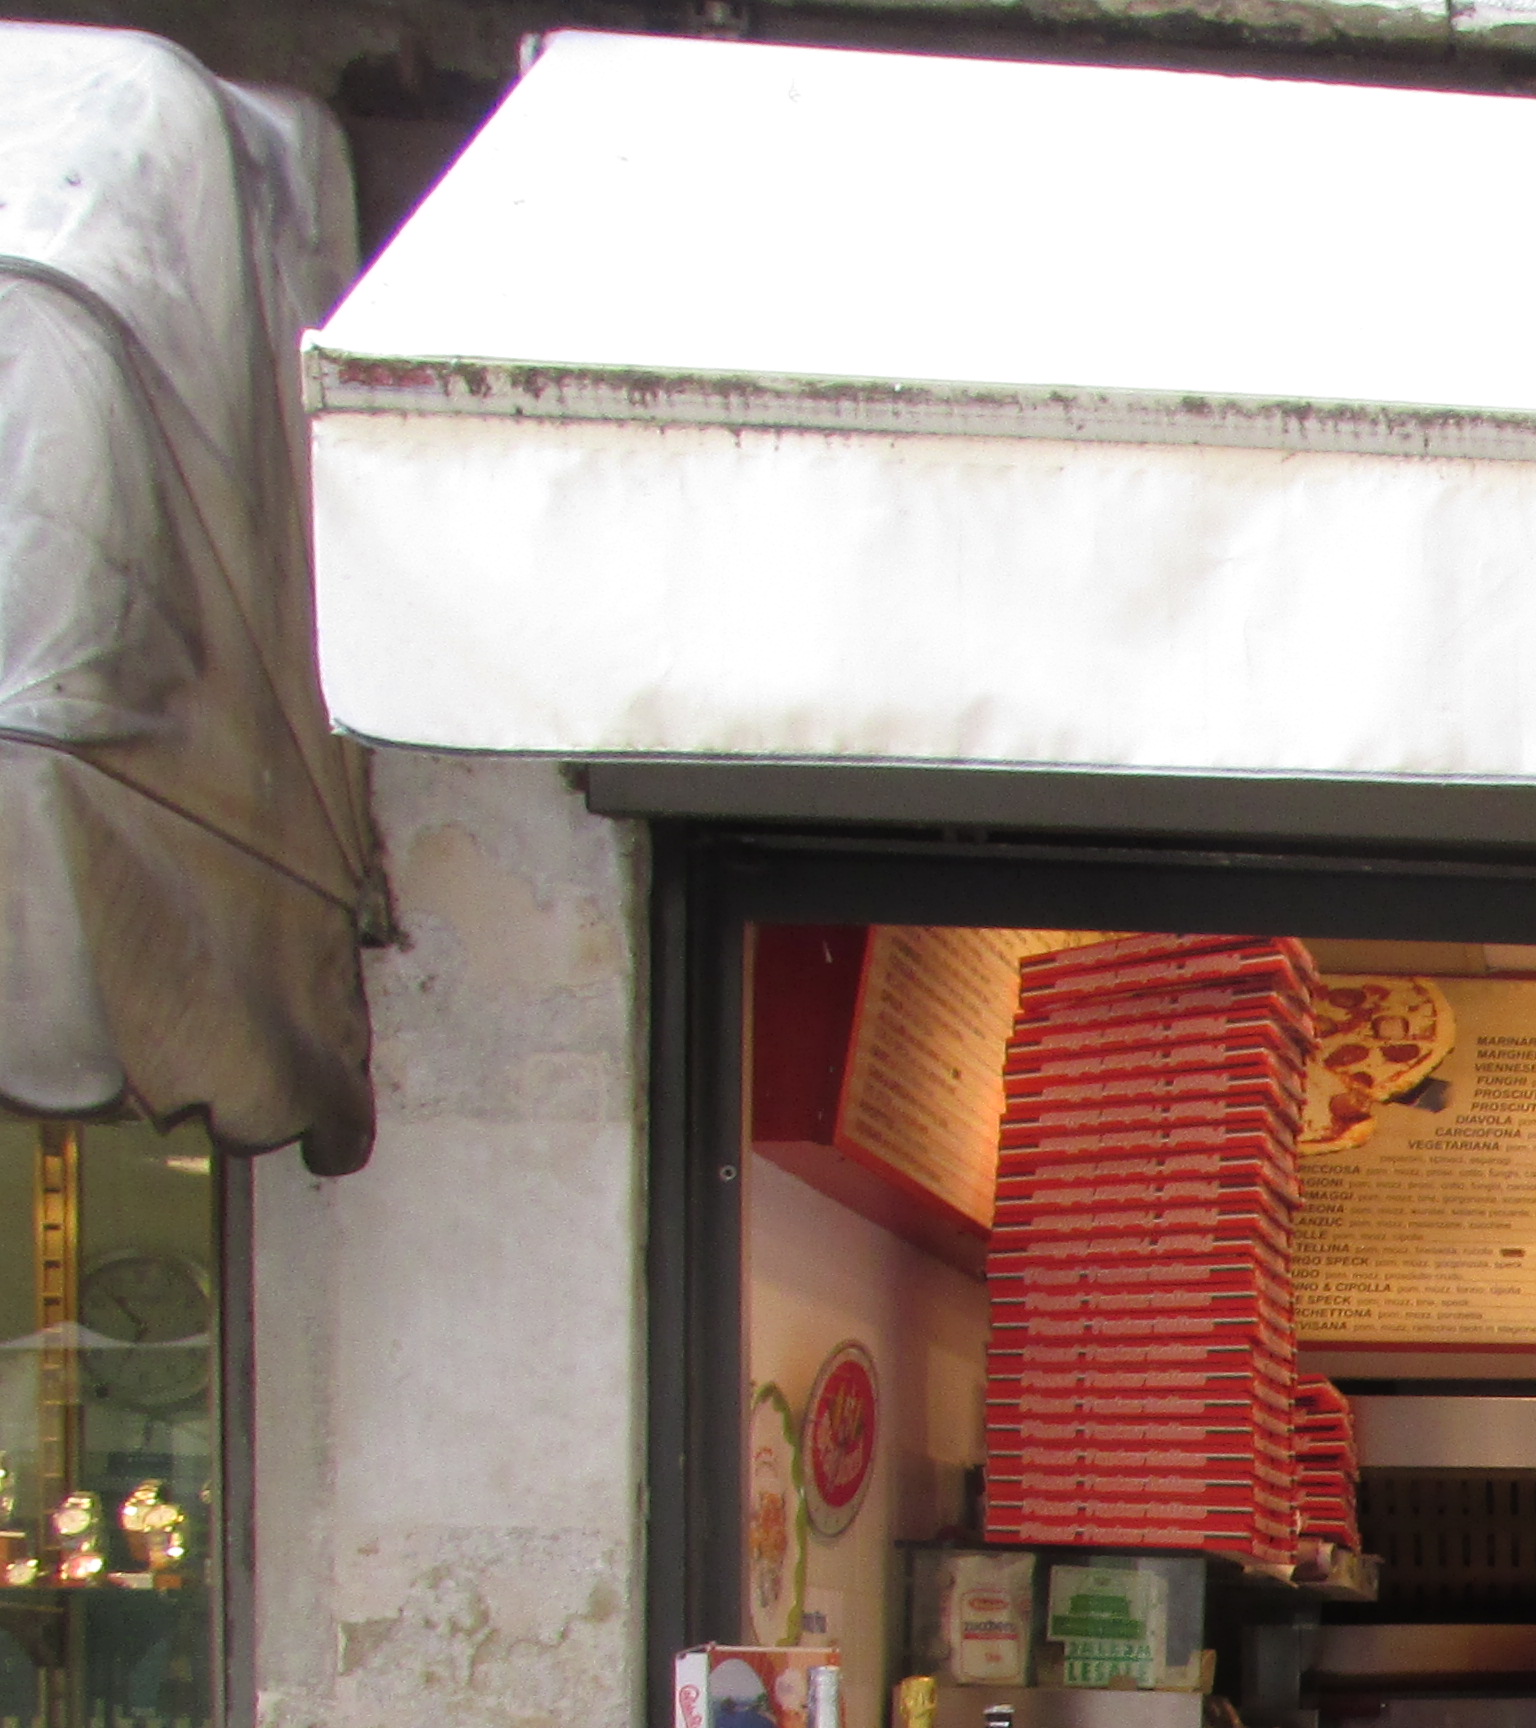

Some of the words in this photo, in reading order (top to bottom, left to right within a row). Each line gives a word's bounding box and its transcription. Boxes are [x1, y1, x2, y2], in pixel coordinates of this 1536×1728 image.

[1477, 1076, 1527, 1086] FUNGHI
[1455, 1115, 1512, 1126] DIAVOLA
[1408, 1140, 1499, 1151] VEGETARIANA
[1298, 1165, 1360, 1175] RICCIOSA
[1297, 1243, 1349, 1253] TELLINA
[1335, 1282, 1391, 1292] CIPOLLA
